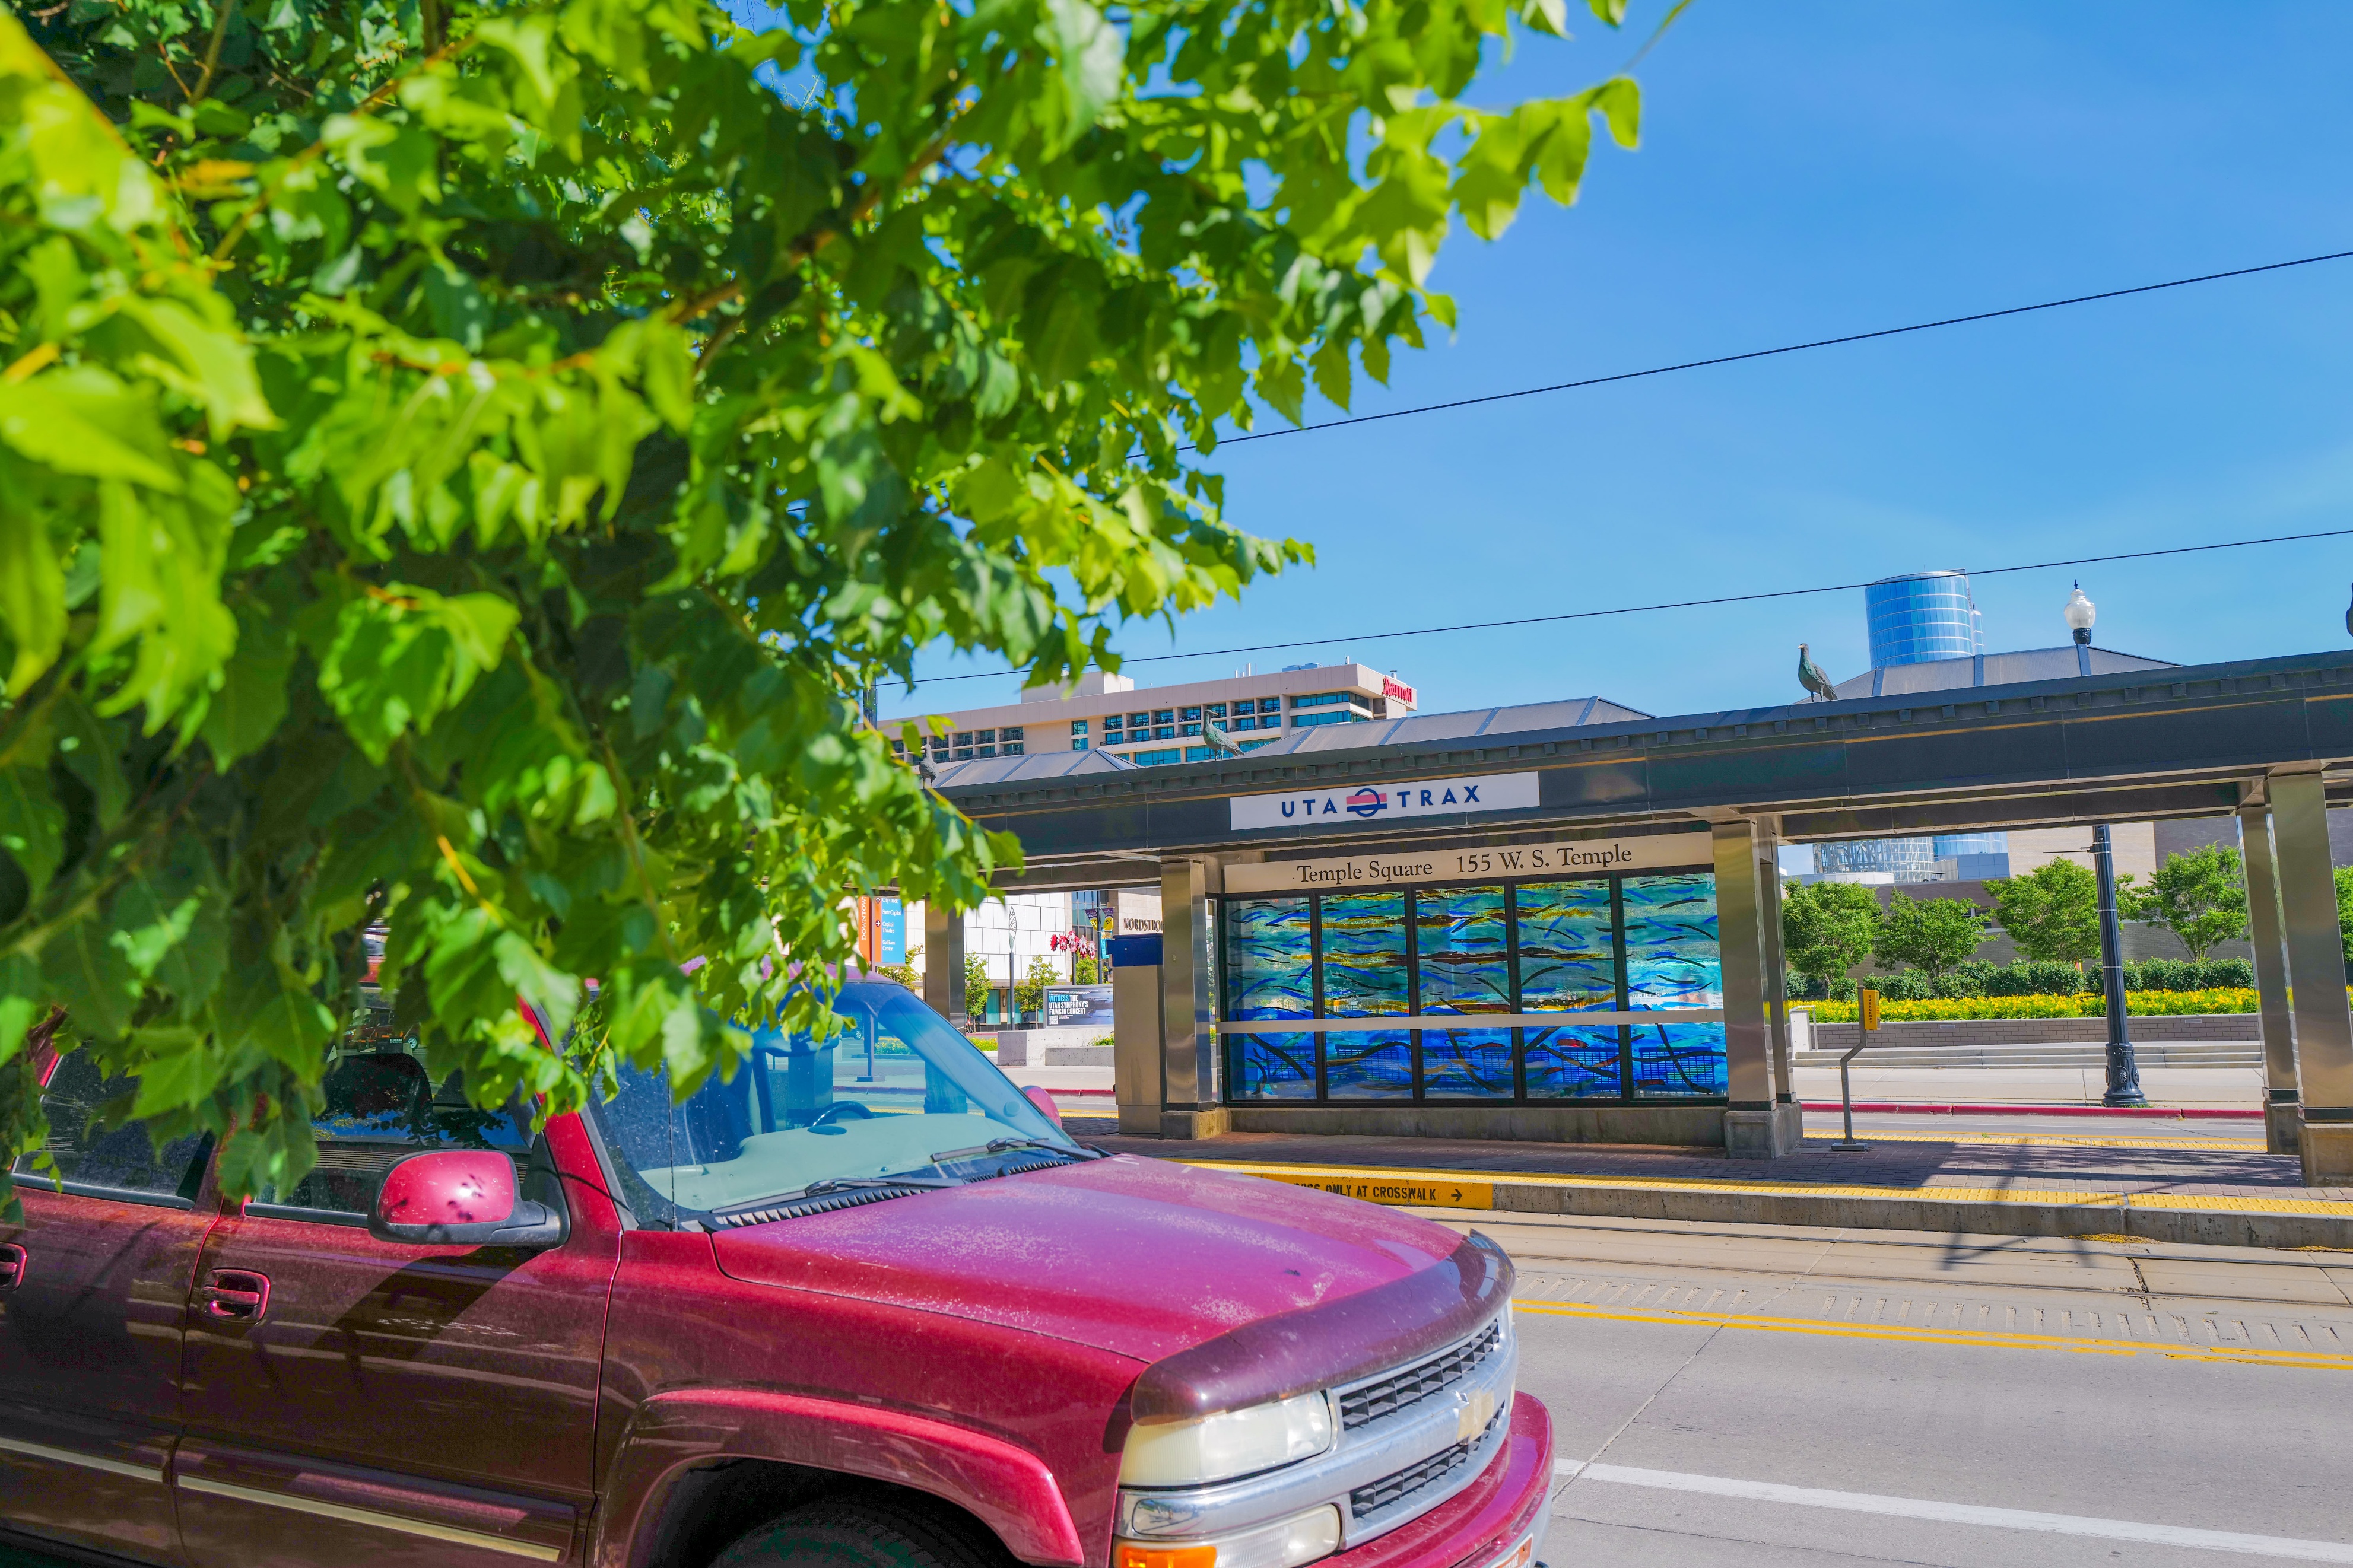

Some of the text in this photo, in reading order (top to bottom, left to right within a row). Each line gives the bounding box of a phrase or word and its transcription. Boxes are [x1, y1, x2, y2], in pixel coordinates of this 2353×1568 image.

[1281, 785, 1481, 818] UTA TRAX
[1297, 844, 1632, 885] Temple Square 155 W. S. Temple
[1325, 1184, 1352, 1197] ONLY
[1357, 1185, 1368, 1197] AT
[1373, 1186, 1436, 1201] CROSSWALK
